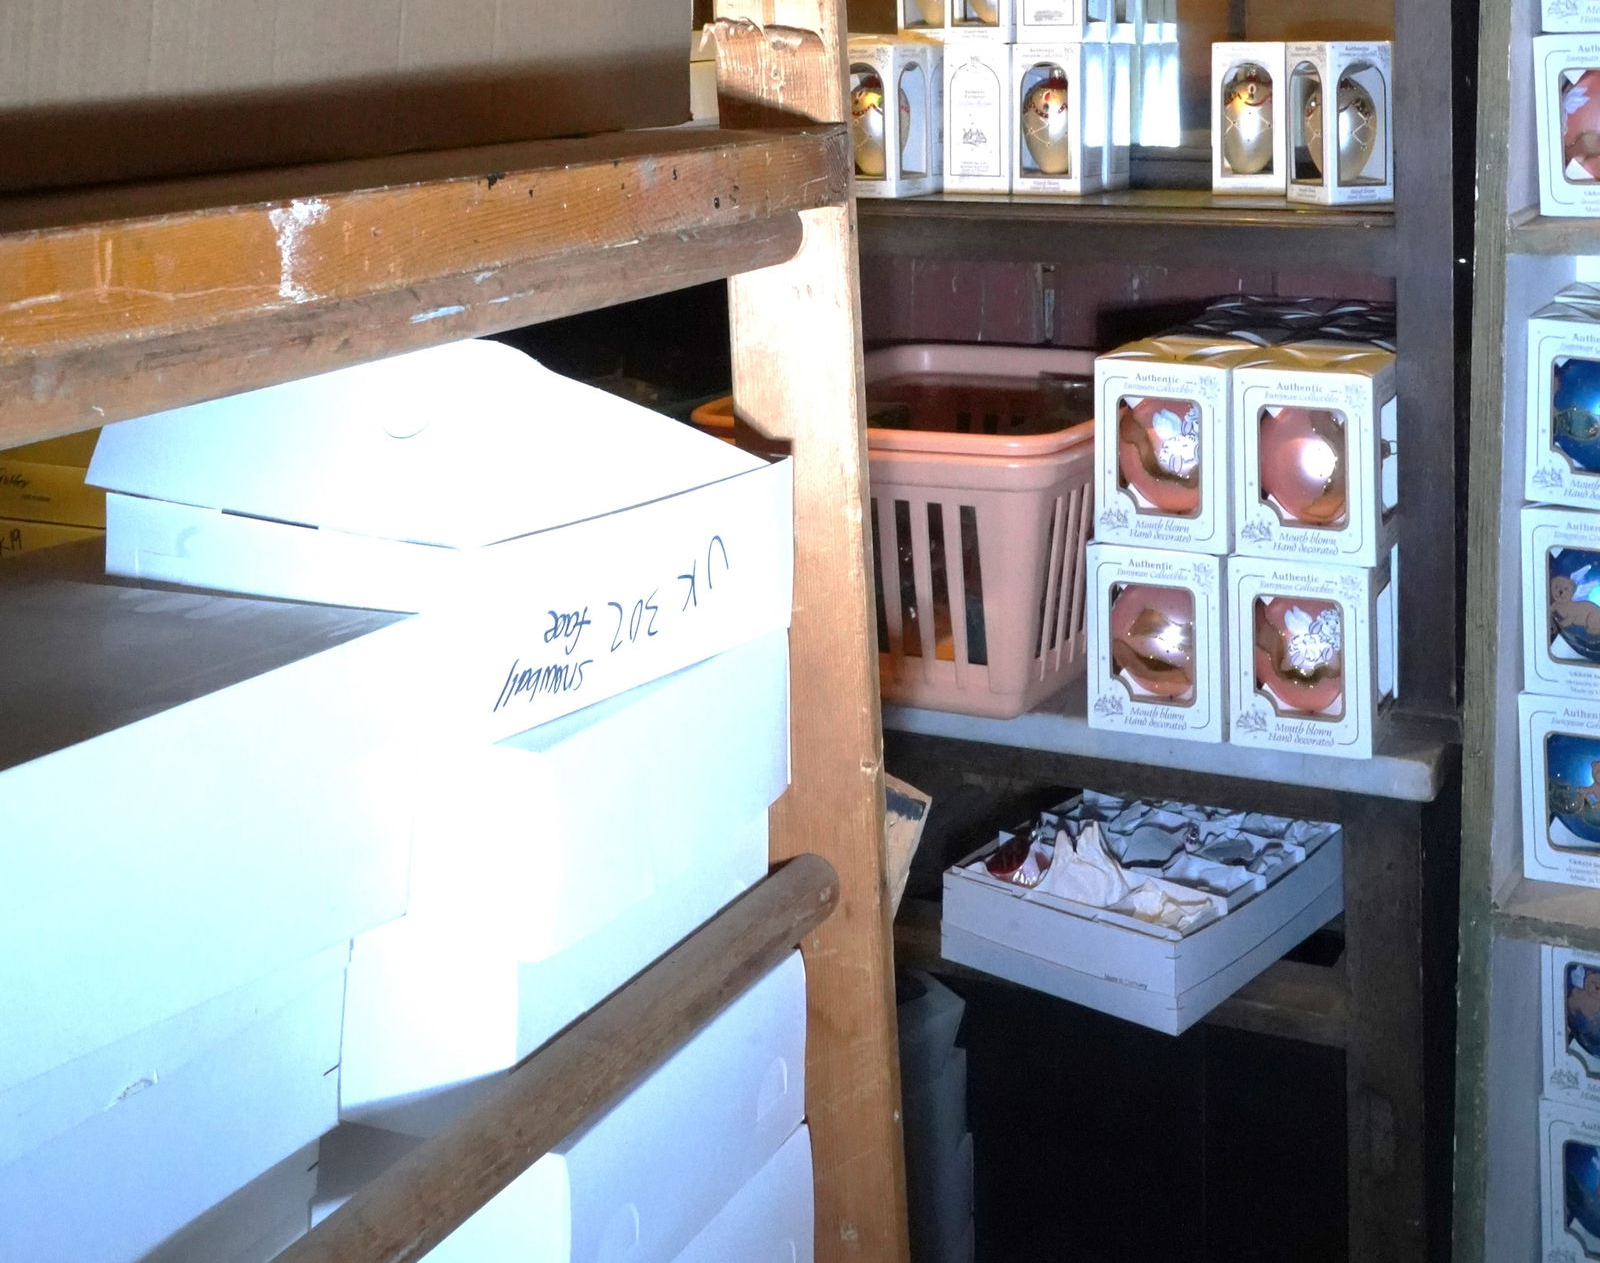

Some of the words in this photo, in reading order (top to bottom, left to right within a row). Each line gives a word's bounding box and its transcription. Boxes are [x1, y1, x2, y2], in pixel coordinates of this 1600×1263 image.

[1135, 373, 1179, 385] Authentic
[1277, 382, 1323, 393] Authentic
[1136, 518, 1163, 530] Mouth
[1164, 520, 1190, 533] blown
[1129, 528, 1153, 539] Hand
[1153, 531, 1192, 543] decorated
[1279, 530, 1309, 543] Mouth
[1310, 532, 1337, 545] blown
[1273, 541, 1297, 552] Hand
[1298, 543, 1339, 556] decorated
[1128, 558, 1174, 571] Authentic
[1271, 571, 1319, 583] Authentic
[1130, 706, 1159, 719] Mouth
[1160, 708, 1185, 721] blown
[1124, 715, 1148, 727] Hand
[1148, 718, 1187, 731] decorated
[1275, 721, 1304, 734] Mouth
[1306, 722, 1333, 737] blown
[1267, 732, 1293, 743] Hand
[1294, 735, 1335, 747] decorated
